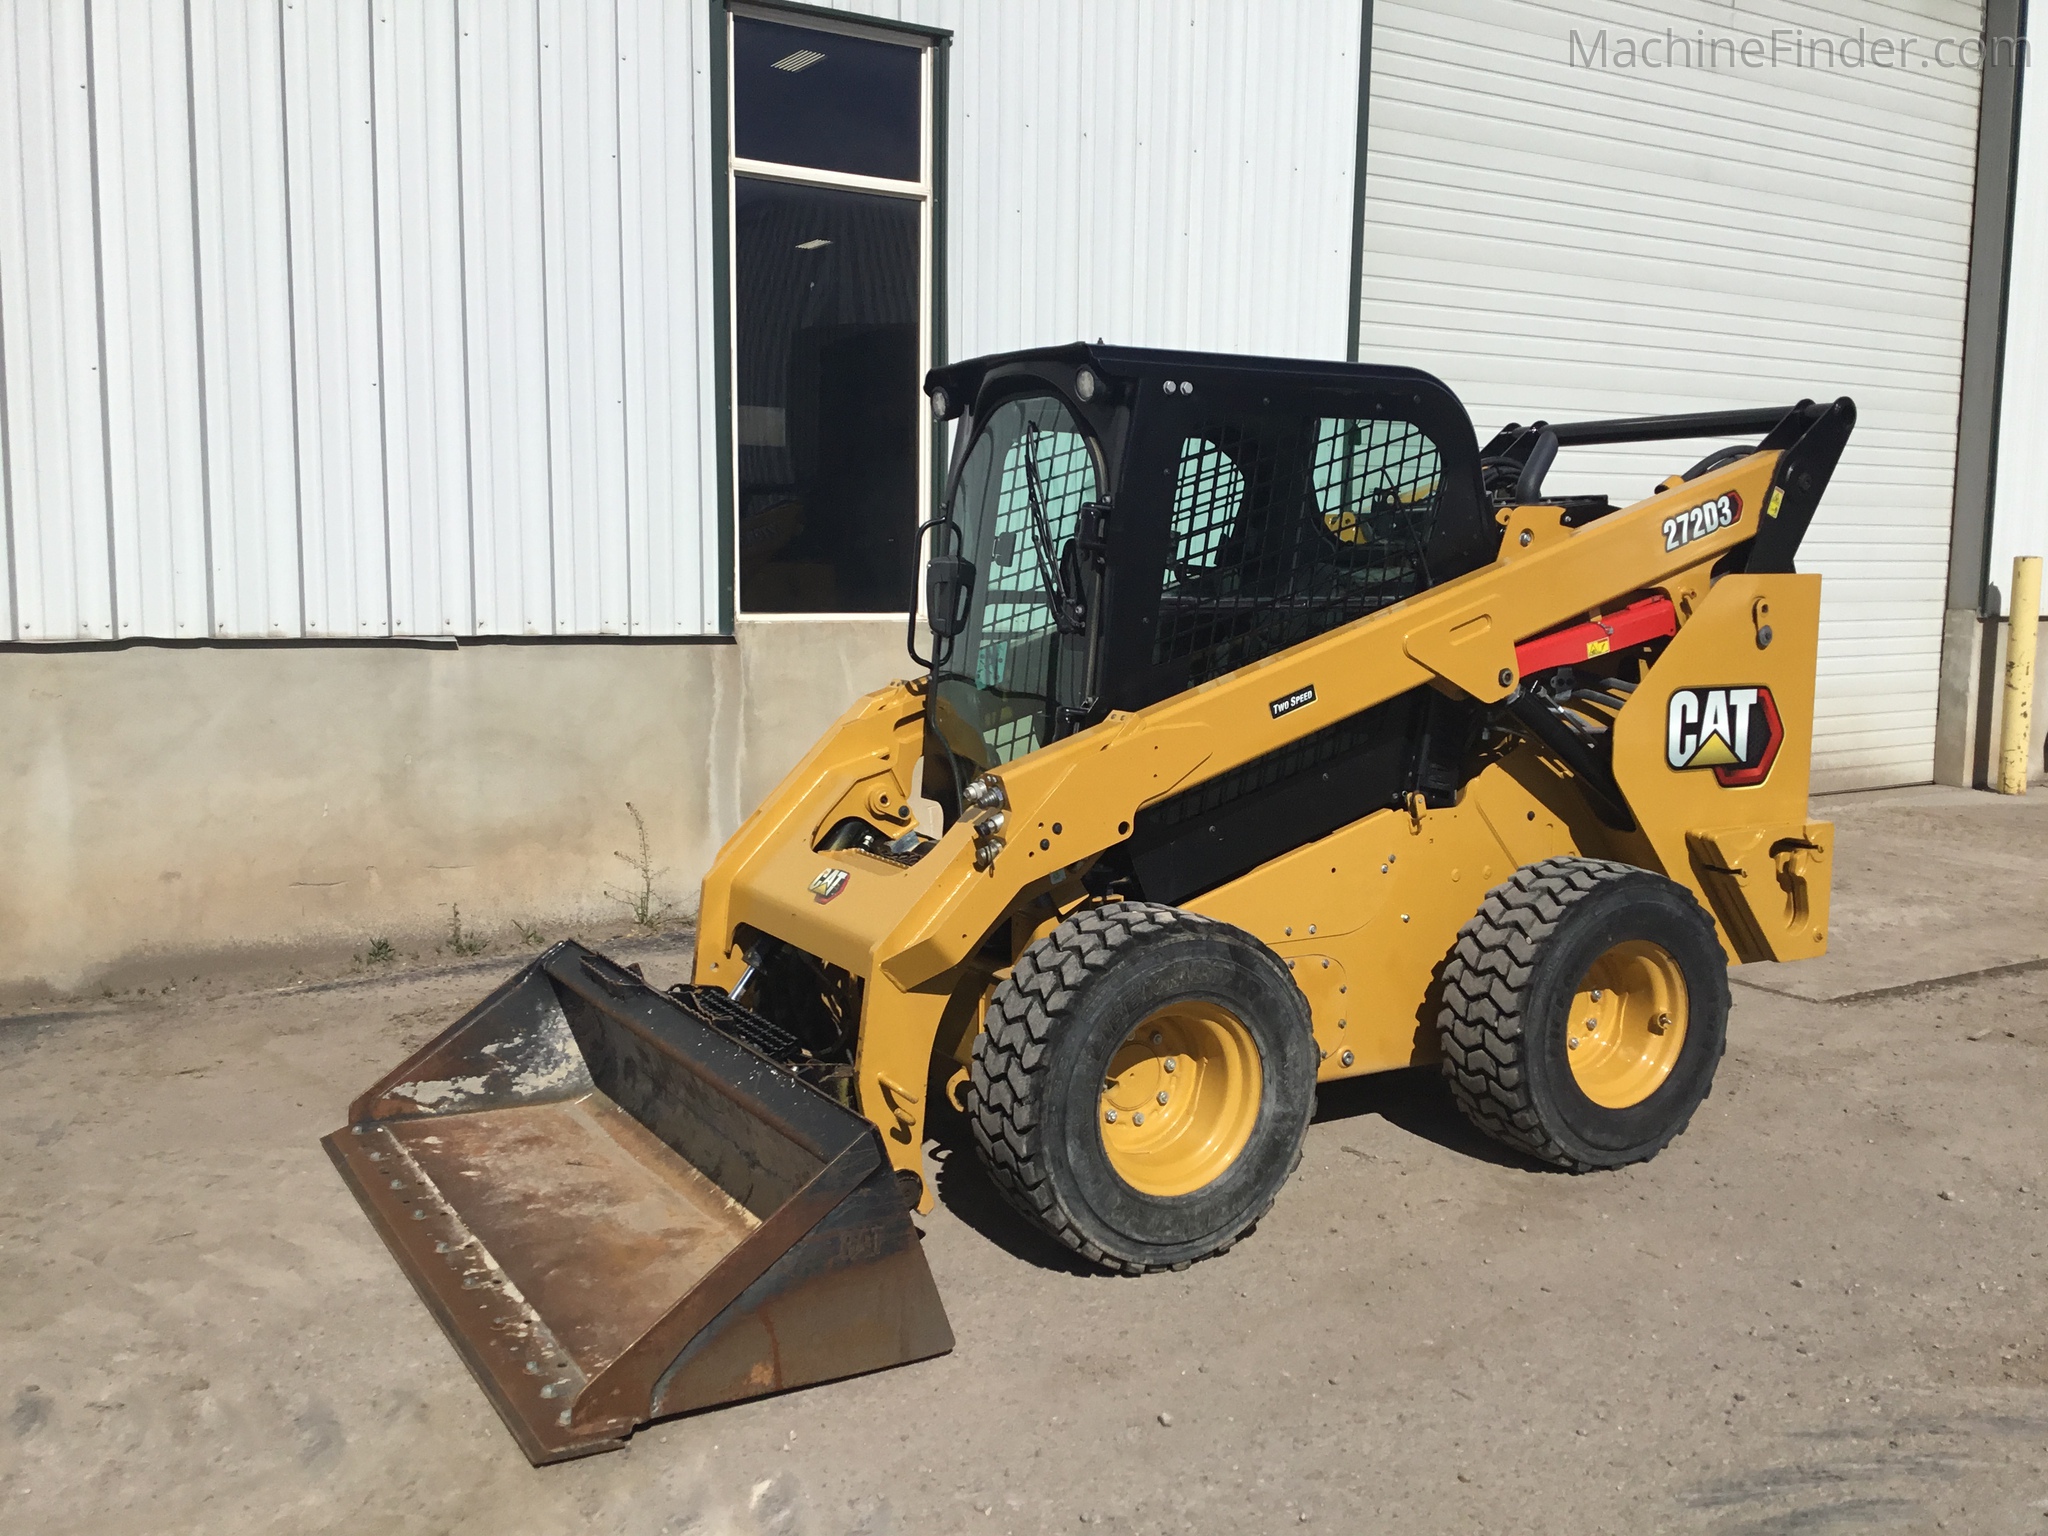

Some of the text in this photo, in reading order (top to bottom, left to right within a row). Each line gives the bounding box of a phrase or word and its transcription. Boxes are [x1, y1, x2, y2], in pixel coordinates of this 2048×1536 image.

[1663, 494, 1733, 552] 272D3
[1668, 688, 1758, 768] CAT
[809, 867, 849, 897] CAT
